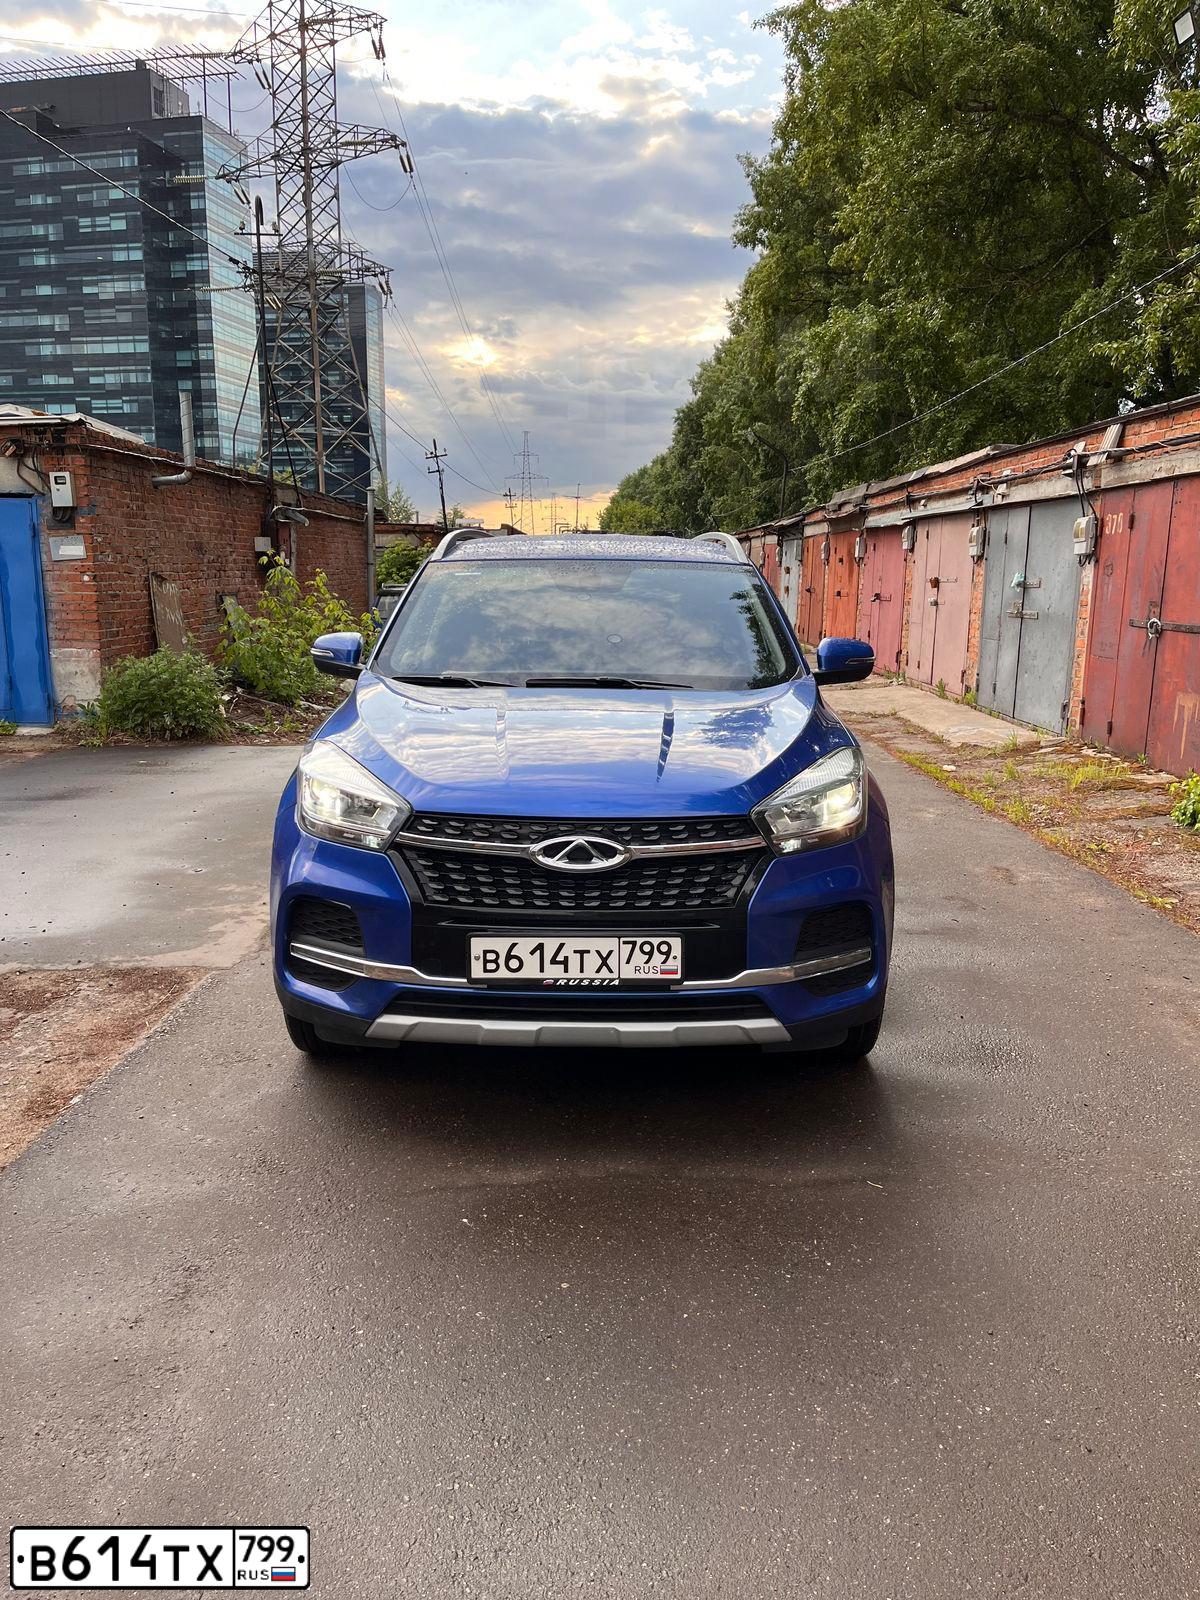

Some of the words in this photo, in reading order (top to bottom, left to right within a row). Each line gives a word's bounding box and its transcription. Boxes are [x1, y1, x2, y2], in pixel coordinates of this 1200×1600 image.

[1105, 512, 1124, 535] 370
[622, 940, 673, 965] 799
[634, 965, 659, 975] RUS
